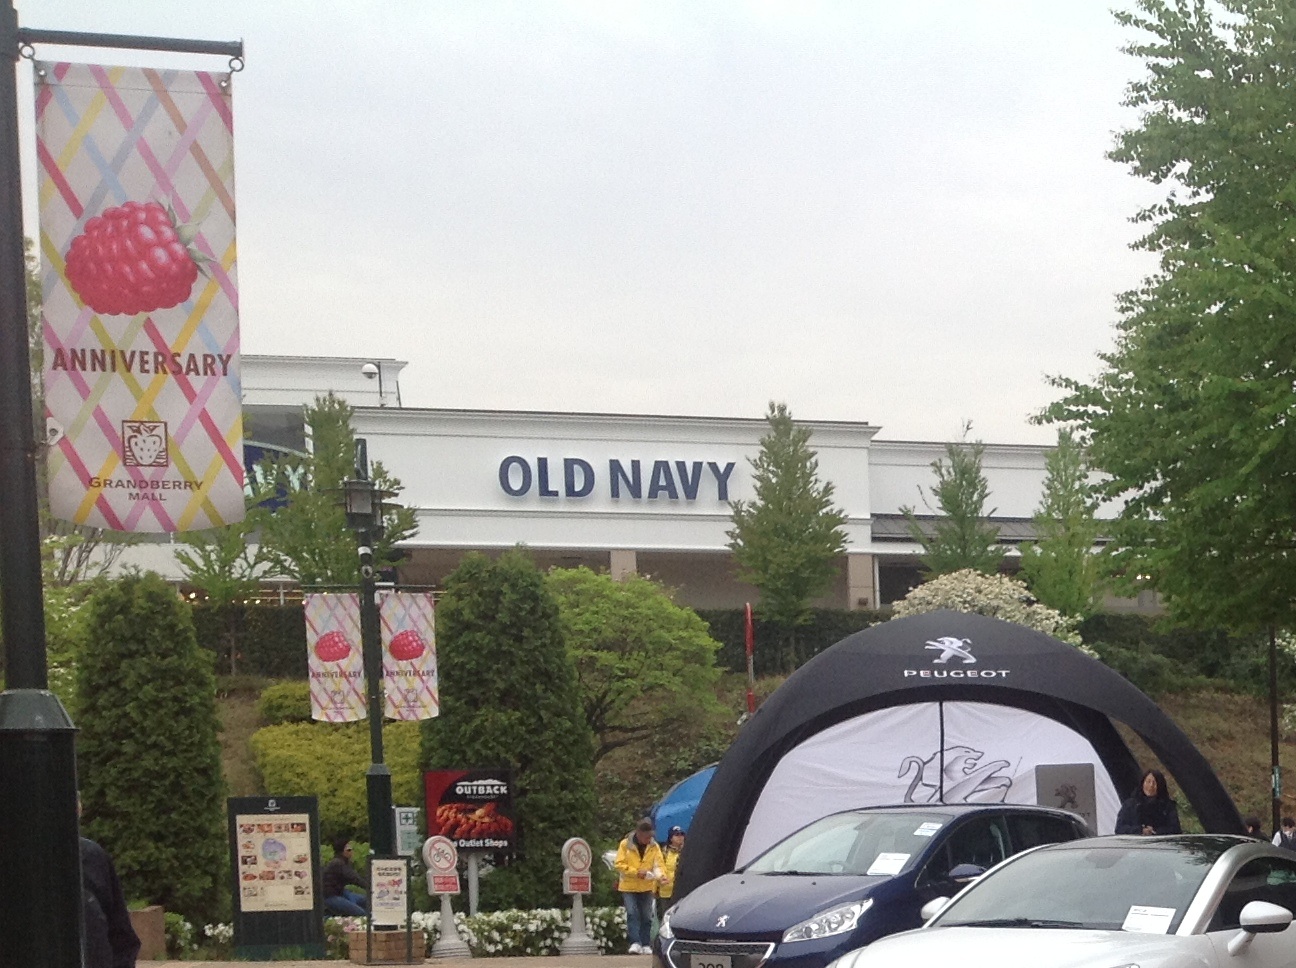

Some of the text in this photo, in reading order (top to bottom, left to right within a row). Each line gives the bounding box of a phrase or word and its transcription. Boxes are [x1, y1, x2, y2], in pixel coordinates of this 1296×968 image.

[51, 347, 232, 377] ANNIVERSARY
[88, 476, 204, 491] GRANDBERRY
[498, 455, 736, 501] OLD NAVY
[127, 491, 167, 502] MALL
[903, 669, 1011, 678] PEUGEOT
[455, 785, 508, 795] OUTBACK
[458, 838, 483, 848] Outlet
[484, 838, 508, 849] Shops
